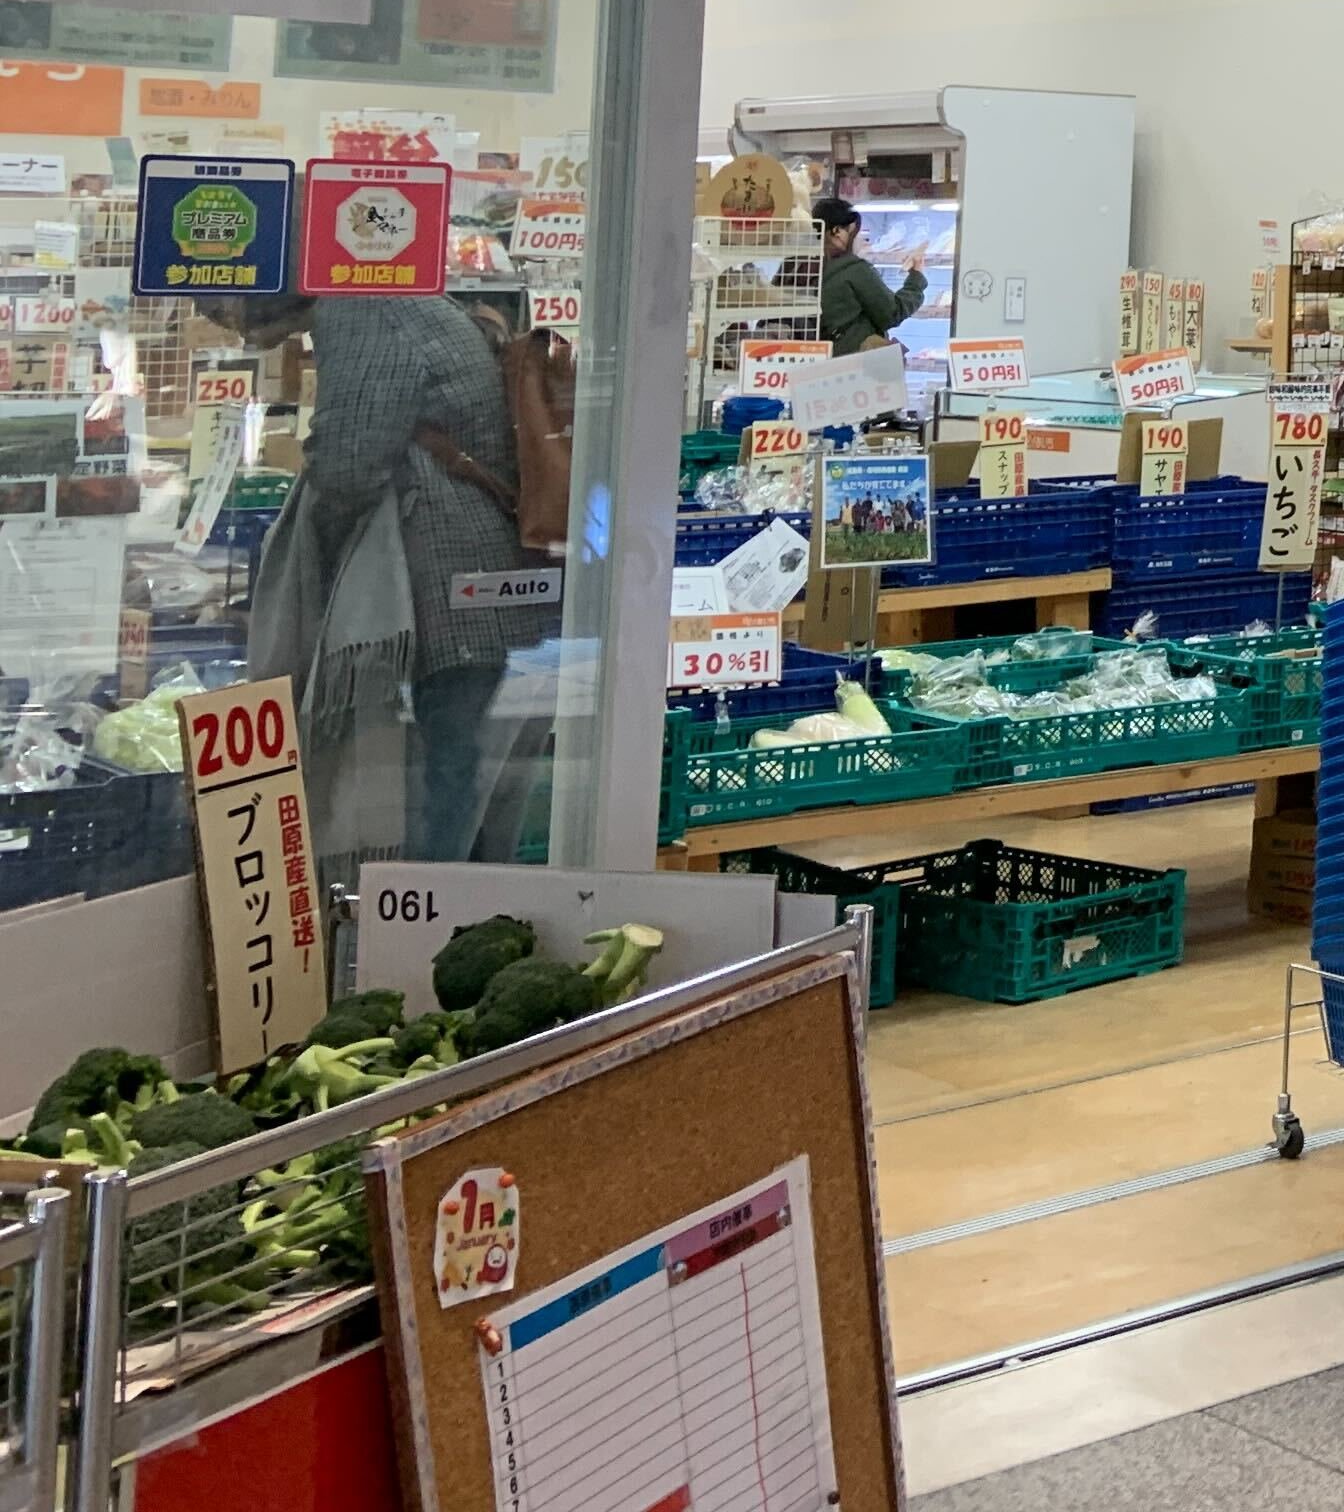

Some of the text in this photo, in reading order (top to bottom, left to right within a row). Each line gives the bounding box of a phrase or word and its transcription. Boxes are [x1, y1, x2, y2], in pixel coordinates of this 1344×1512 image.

[181, 211, 248, 226] プレミアム
[189, 226, 237, 241] 商品券
[165, 264, 257, 286] 参加店舗
[330, 263, 417, 286] 参加店舗
[533, 296, 578, 322] 250
[962, 364, 1022, 383] 50円引
[199, 376, 247, 401] 250
[1130, 376, 1185, 401] 50円引
[1276, 412, 1323, 441] 780
[754, 426, 802, 454] 220
[1268, 454, 1304, 557] いちご
[499, 580, 549, 597] Auto
[683, 649, 769, 677] 30%引
[277, 793, 316, 974] 田原産直送!
[227, 791, 274, 1056] ブロッコリー
[459, 1179, 497, 1234] 1月
[455, 1231, 500, 1253] January
[497, 1362, 505, 1379] 1
[500, 1384, 509, 1403] 2
[502, 1406, 512, 1426] 3
[505, 1429, 515, 1448] 4
[507, 1453, 517, 1472] 5
[509, 1476, 519, 1495] 6
